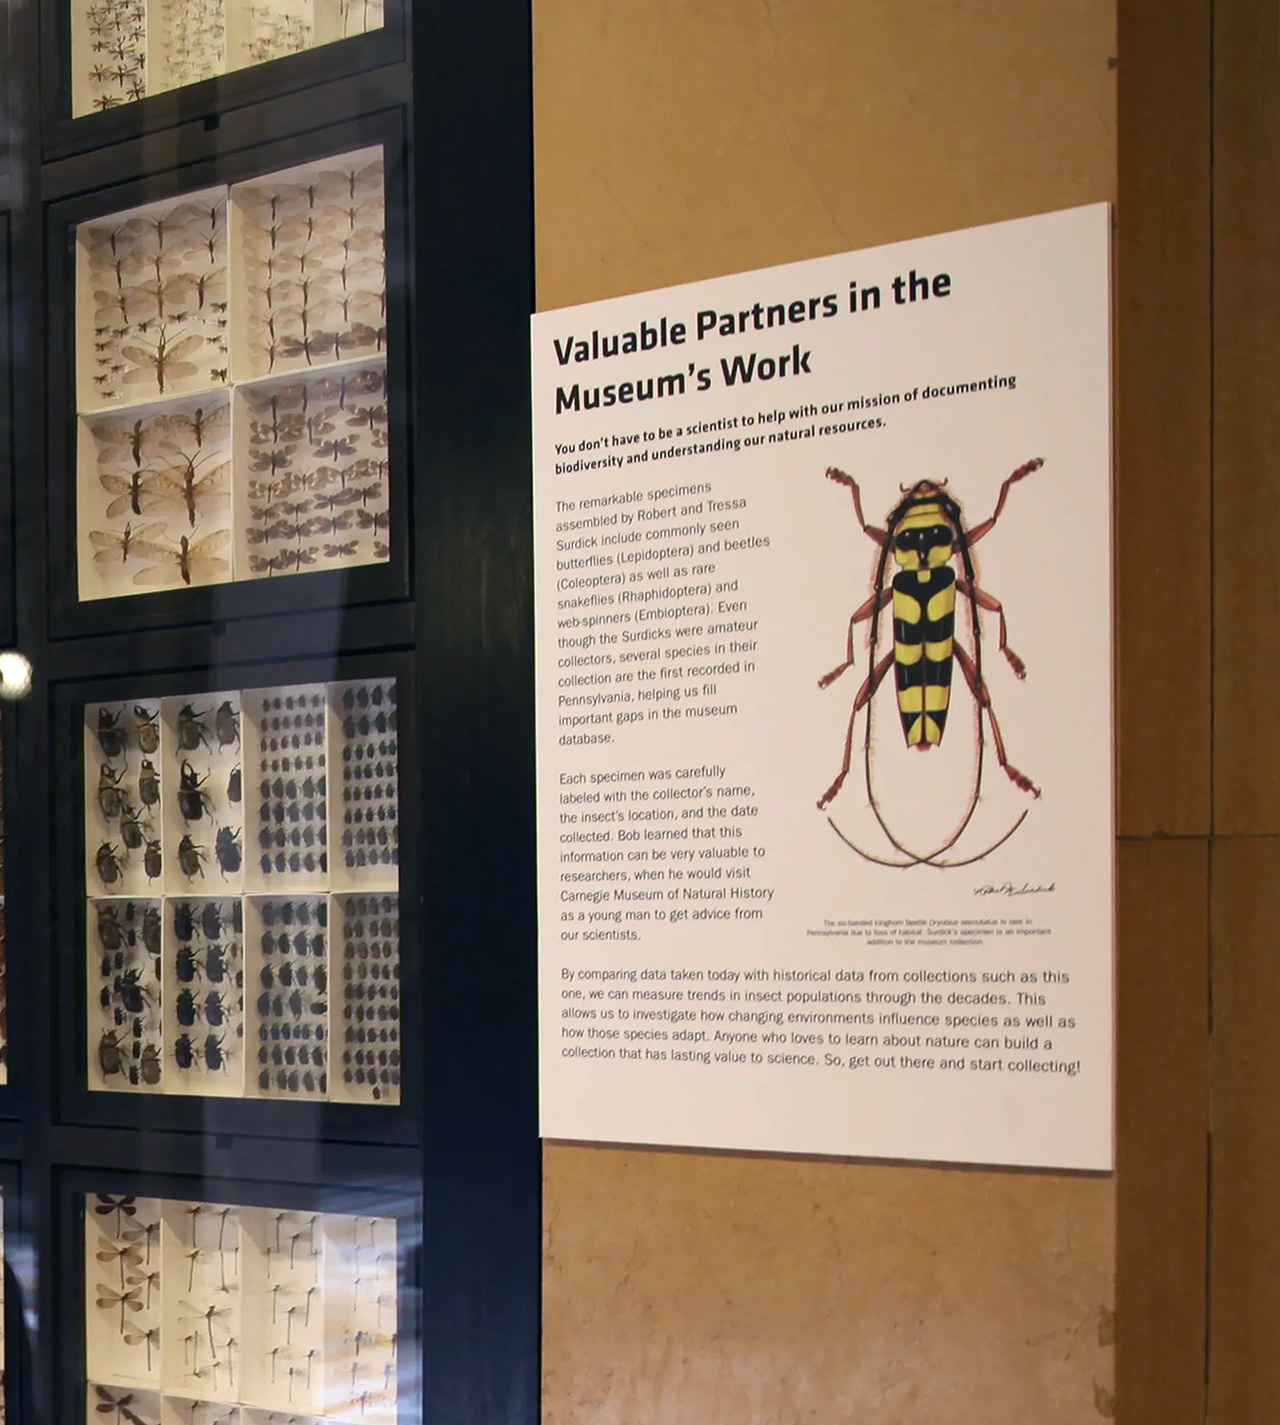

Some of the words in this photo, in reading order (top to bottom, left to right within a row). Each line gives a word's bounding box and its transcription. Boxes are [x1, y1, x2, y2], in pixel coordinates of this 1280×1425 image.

[554, 317, 686, 366] Valuable
[697, 294, 838, 341] Partners
[850, 281, 880, 313] in
[892, 270, 950, 304] the
[556, 364, 711, 415] Museum's
[720, 346, 810, 386] Work
[555, 444, 575, 455] You
[579, 437, 608, 451] don't
[612, 434, 640, 446] have
[643, 431, 655, 442] to
[659, 428, 672, 440] be
[676, 428, 682, 437] a
[686, 417, 738, 435] scientist
[742, 416, 754, 427] to
[758, 410, 785, 425] help
[789, 404, 818, 419] with
[822, 403, 844, 414] our
[848, 394, 900, 411] mission
[904, 388, 918, 401] of
[922, 376, 1016, 399] documenting
[556, 455, 624, 475] biodiversity
[627, 450, 648, 464] and
[652, 438, 740, 460] understanding
[744, 435, 765, 446] our
[769, 424, 814, 443] natural
[819, 418, 886, 436] resources.
[556, 501, 575, 512] The
[580, 490, 643, 509] remarkable
[647, 483, 711, 502] specimens
[556, 513, 617, 532] assembled
[621, 512, 634, 526] by
[638, 506, 677, 521] Robert
[681, 502, 703, 516] and
[707, 499, 746, 512] Tressa
[556, 536, 598, 551] Surdick
[601, 530, 642, 546] include
[646, 522, 706, 540] commonly
[710, 520, 739, 533] seen
[556, 555, 613, 571] butterflies
[617, 544, 694, 566] (Lepidoptera)
[698, 540, 720, 554] and
[724, 536, 770, 551] beetles
[557, 571, 626, 592] (Coleoptera)
[629, 572, 644, 582] as
[647, 567, 669, 580] well
[673, 567, 688, 577] as
[692, 564, 716, 575] rare
[558, 594, 614, 610] snakeflies
[618, 582, 712, 605] (Rhaphidoptera)
[716, 579, 738, 594] and
[557, 613, 631, 628] web-spinners
[634, 602, 714, 623] (Embioptera).
[718, 600, 746, 614] Even
[558, 634, 596, 649] though
[600, 633, 618, 645] the
[622, 627, 672, 643] Surdicks
[675, 626, 703, 638] were
[707, 621, 758, 635] amateur
[558, 654, 616, 668] collectors,
[619, 647, 660, 663] several
[665, 644, 710, 661] species
[714, 642, 725, 655] in
[729, 639, 757, 653] their
[558, 673, 611, 688] collection
[615, 672, 634, 683] are
[638, 669, 656, 681] the
[660, 667, 684, 680] first
[687, 660, 740, 677] recorded
[744, 660, 754, 672] in
[558, 691, 634, 707] Pennsylvania,
[638, 687, 681, 702] helping
[684, 687, 698, 698] us
[702, 683, 716, 696] fill
[559, 712, 613, 727] important
[616, 711, 644, 725] gaps
[648, 708, 658, 720] in
[662, 707, 681, 719] the
[686, 705, 737, 717] museum
[560, 772, 586, 785] Each
[590, 771, 645, 785] specimen
[649, 770, 672, 780] was
[676, 766, 725, 780] carefully
[560, 791, 600, 805] labeled
[604, 790, 626, 802] with
[631, 790, 649, 801] the
[653, 786, 712, 800] collector's
[717, 787, 754, 798] name,
[560, 813, 577, 824] the
[582, 810, 624, 823] insect's
[628, 808, 678, 821] location,
[681, 806, 704, 819] and
[708, 805, 727, 818] the
[730, 805, 758, 817] date
[560, 830, 614, 843] collected.
[618, 829, 640, 842] Bob
[644, 827, 688, 841] learned
[692, 827, 716, 839] that
[720, 826, 742, 838] this
[560, 850, 624, 863] information
[627, 851, 648, 861] can
[652, 848, 666, 861] be
[670, 850, 695, 862] very
[698, 846, 749, 859] valuable
[753, 846, 765, 857] to
[560, 870, 630, 882] researchers,
[634, 869, 664, 881] when
[668, 868, 683, 880] he
[687, 867, 722, 880] would
[726, 866, 751, 879] visit
[560, 889, 610, 904] Carnegie
[614, 889, 664, 901] Museum
[667, 888, 680, 900] of
[683, 887, 726, 900] Natural
[730, 886, 774, 901] History
[561, 912, 574, 921] as
[578, 912, 585, 921] a
[588, 910, 622, 924] young
[626, 911, 650, 921] man
[654, 909, 666, 920] to
[670, 909, 688, 923] get
[692, 907, 731, 920] advice
[735, 907, 762, 919] from
[562, 968, 575, 982] By
[578, 968, 638, 983] comparing
[640, 969, 666, 981] data
[670, 969, 704, 981] taken
[708, 970, 740, 983] today
[744, 969, 769, 982] with
[773, 969, 831, 982] historical
[835, 969, 864, 983] data
[869, 970, 899, 982] from
[903, 970, 977, 983] collections
[982, 971, 1015, 983] such
[1020, 973, 1038, 983] as
[1043, 971, 1069, 983] this
[562, 1046, 615, 1058] collection
[619, 1047, 642, 1059] that
[646, 1048, 667, 1060] has
[671, 1049, 711, 1064] lasting
[714, 1050, 746, 1063] value
[750, 1052, 763, 1063] to
[767, 1052, 818, 1065] science.
[824, 1053, 845, 1067] So,
[849, 1056, 870, 1069] get
[874, 1056, 896, 1067] out
[900, 1056, 935, 1069] there
[940, 1057, 965, 1070] and
[970, 1058, 1002, 1070] start
[1008, 1059, 1080, 1076] collecting!
